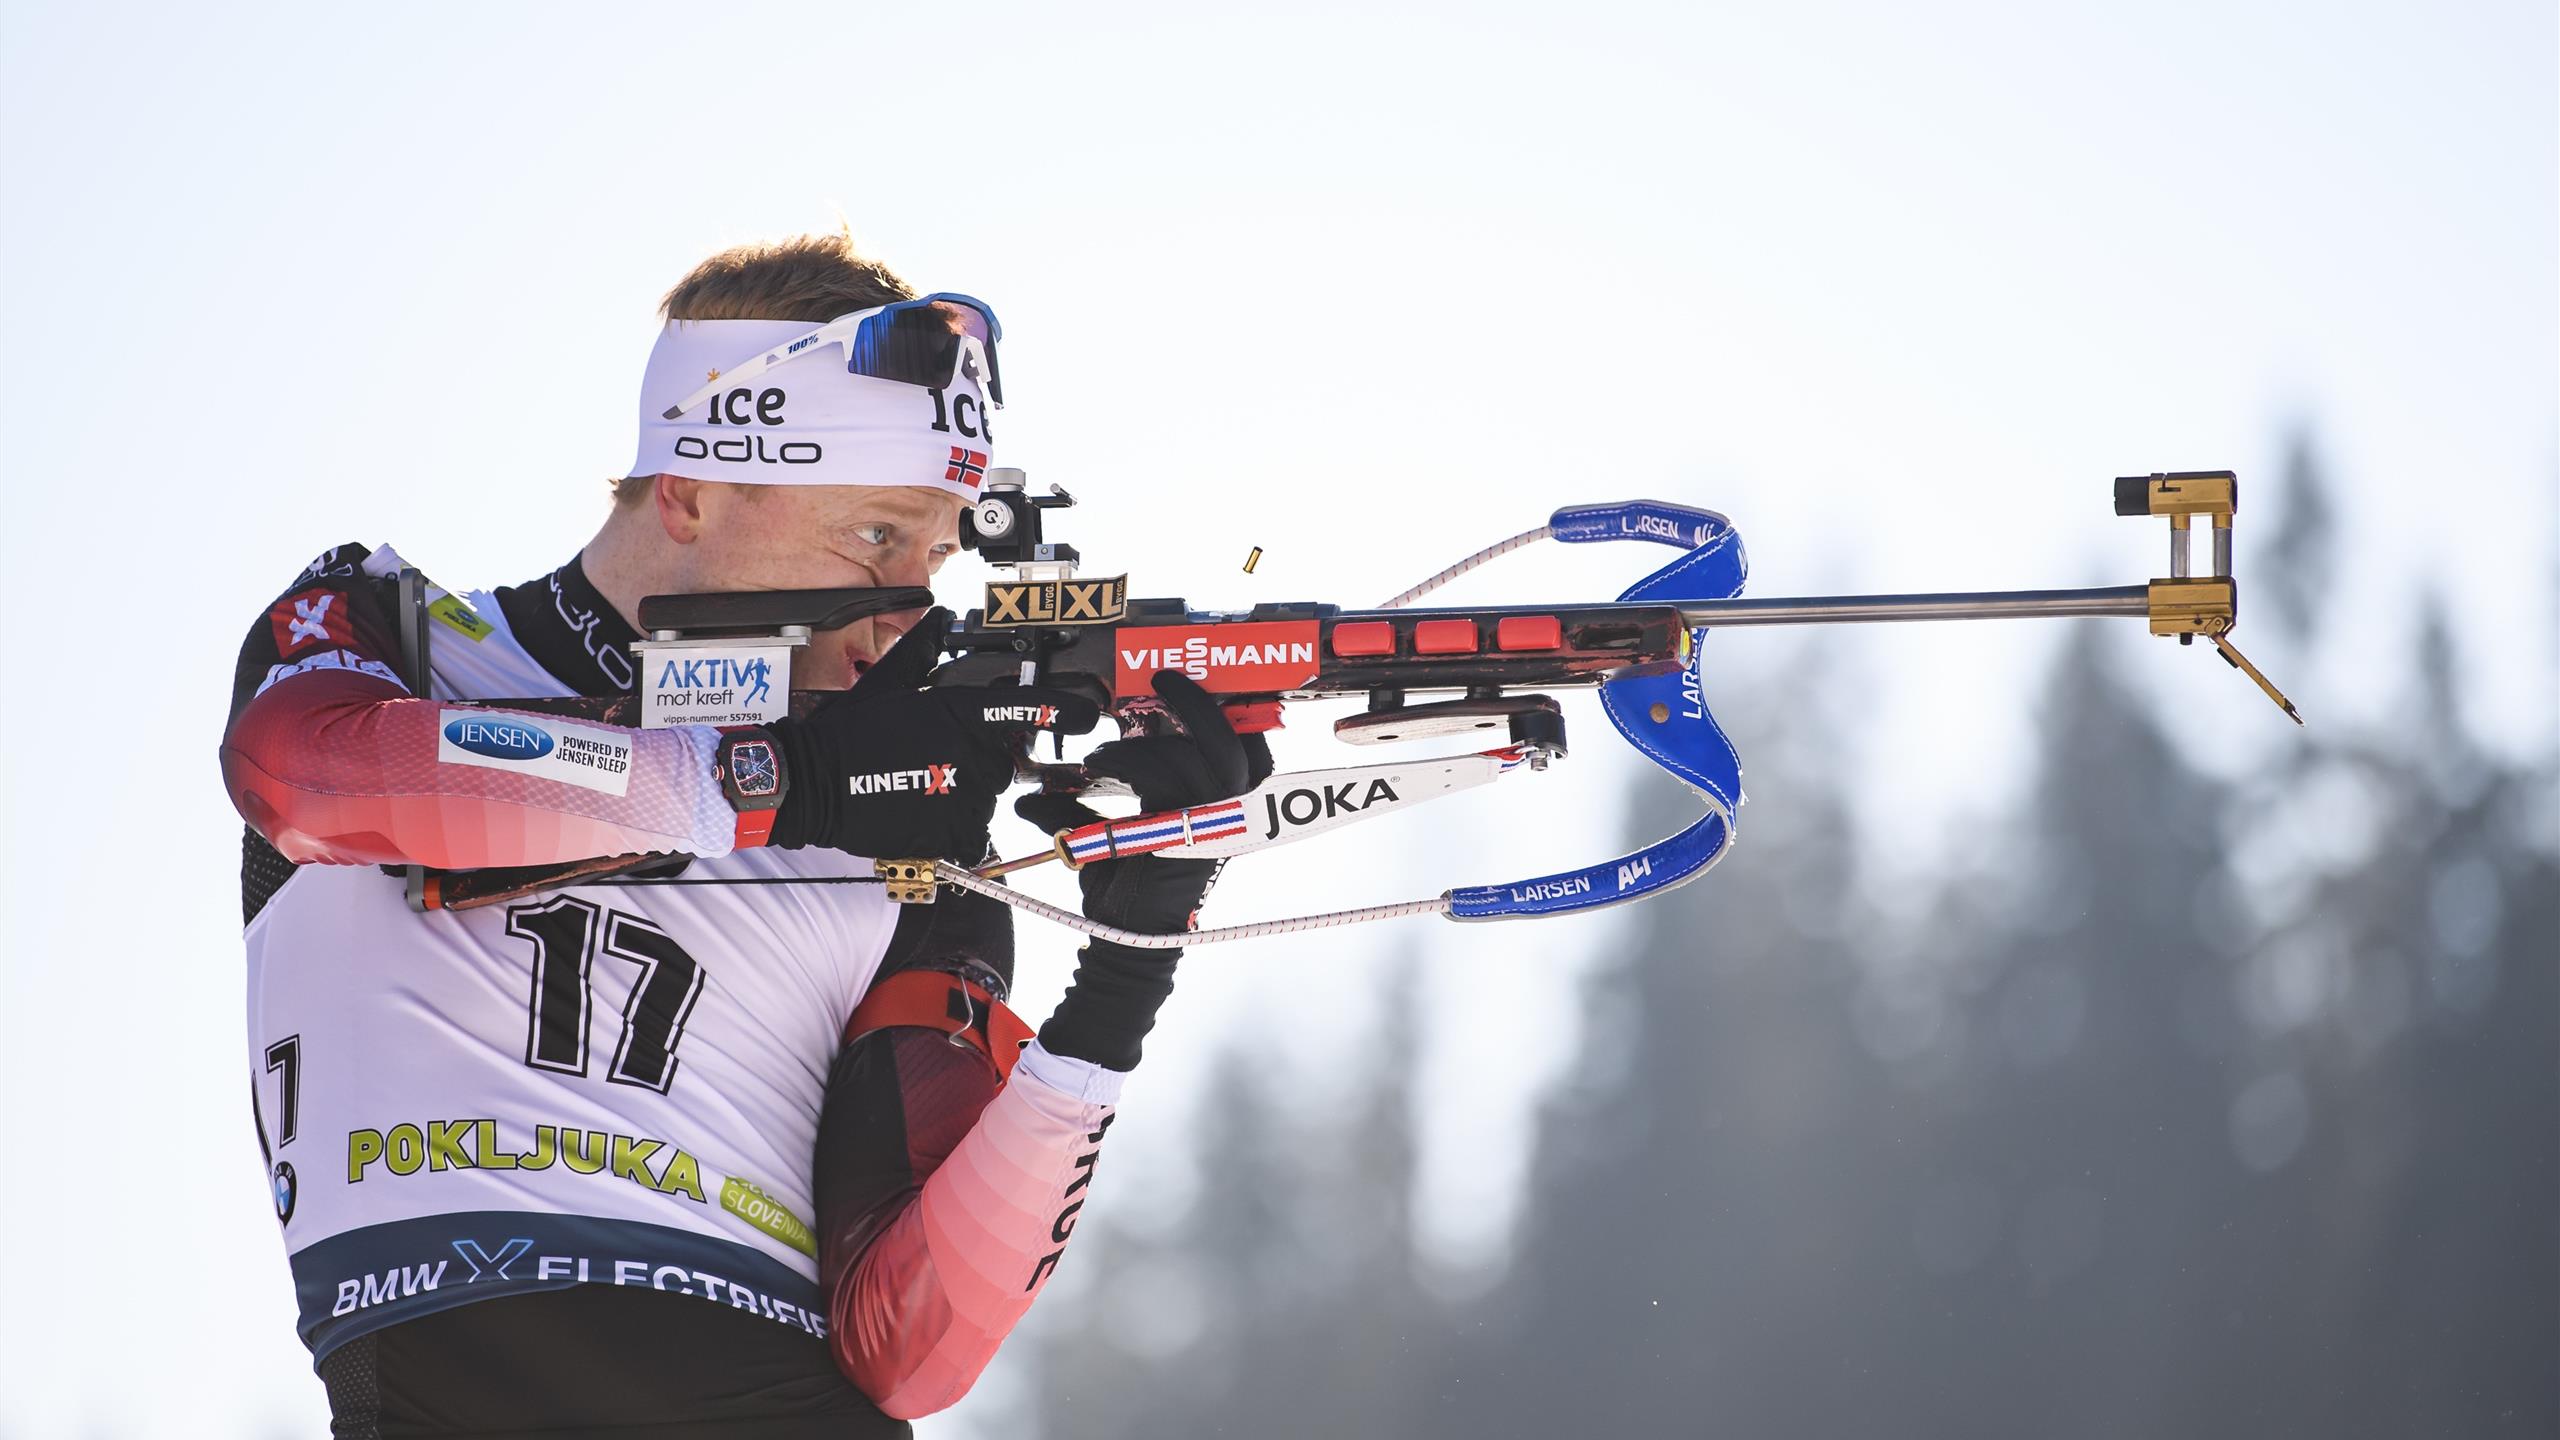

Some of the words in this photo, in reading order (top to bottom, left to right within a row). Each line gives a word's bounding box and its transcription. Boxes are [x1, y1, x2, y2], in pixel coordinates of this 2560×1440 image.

[788, 333, 818, 354] 100%
[1621, 516, 1680, 540] LARSEN
[1121, 637, 1313, 681] VIESSMANN
[657, 658, 754, 689] AKTIV
[657, 689, 692, 706] mot
[696, 689, 734, 706] kreft
[663, 715, 728, 724] vipps-nummer
[729, 713, 763, 722] 557591
[458, 724, 540, 751] JENSEN
[563, 735, 612, 756] POWERED
[614, 746, 629, 760] BY
[556, 747, 594, 768] JENSEN
[597, 756, 627, 775] SLEEP
[1511, 876, 1590, 903] LARSEN
[505, 893, 707, 1096] 17
[348, 1119, 708, 1205] POKLJUKA
[726, 1189, 808, 1246] SLOVENIA
[331, 1259, 449, 1318] BMW
